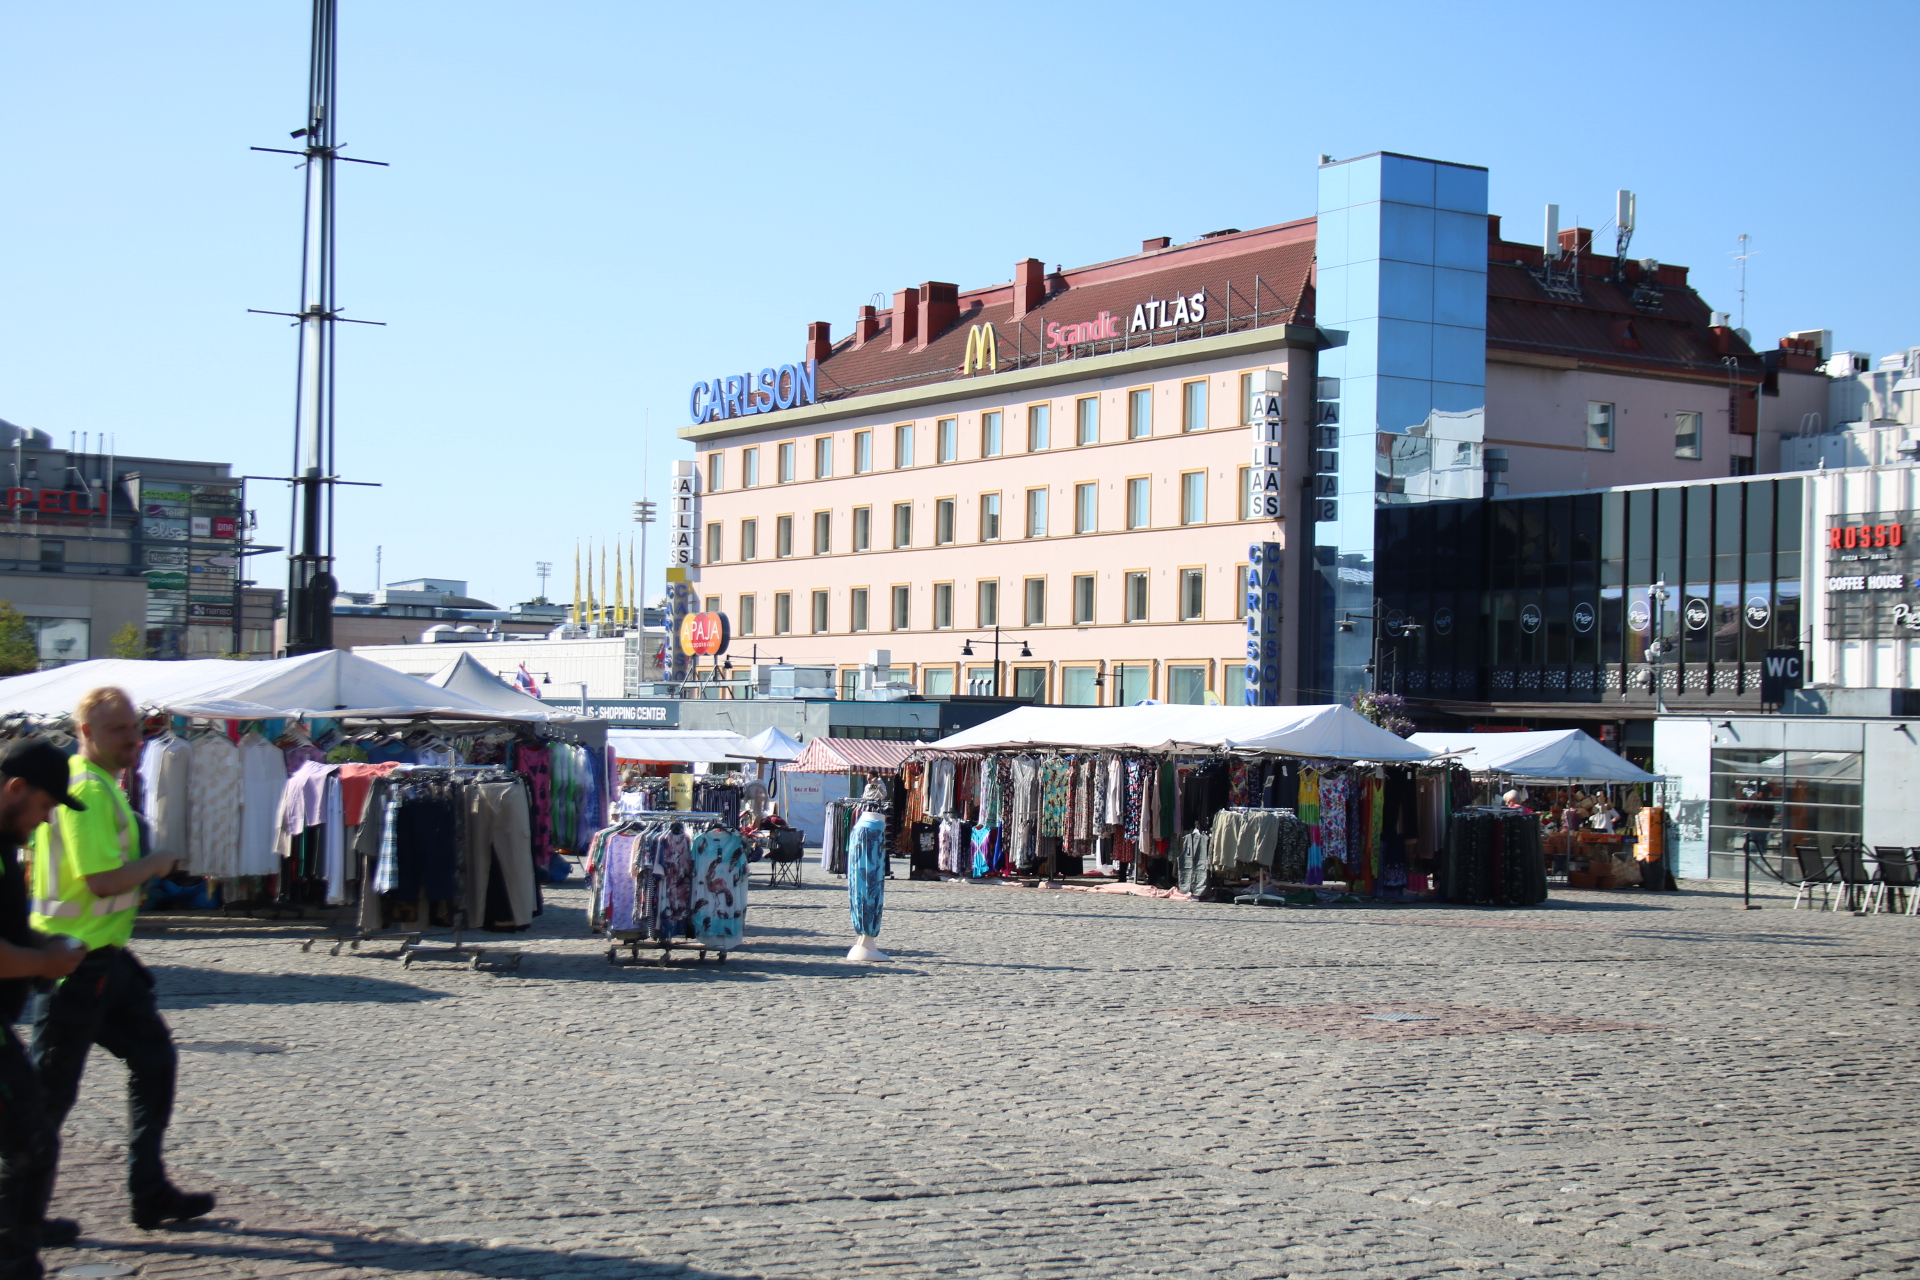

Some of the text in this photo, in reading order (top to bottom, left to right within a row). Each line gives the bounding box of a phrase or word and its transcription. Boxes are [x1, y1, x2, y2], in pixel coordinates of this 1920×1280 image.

[1047, 293, 1206, 349] Scandic ATLAS
[690, 359, 818, 424] CARLSON
[1252, 398, 1264, 516] ATLAS
[1265, 398, 1280, 516] ATLAS
[0, 487, 108, 515] PELI
[148, 522, 184, 538] elisa
[218, 523, 234, 531] DNA
[678, 479, 691, 564] ATLAS
[1829, 523, 1903, 549] ROSSO
[149, 576, 186, 584] pecsavers
[1829, 574, 1904, 590] COFFEE HOUSE
[206, 608, 232, 616] nanso
[1245, 544, 1261, 706] CARLSON
[1263, 544, 1280, 706] CARLSON
[682, 619, 720, 641] APAJA
[1766, 656, 1799, 678] WC
[599, 706, 635, 720] SHOPPING
[637, 707, 667, 721] CENTER
